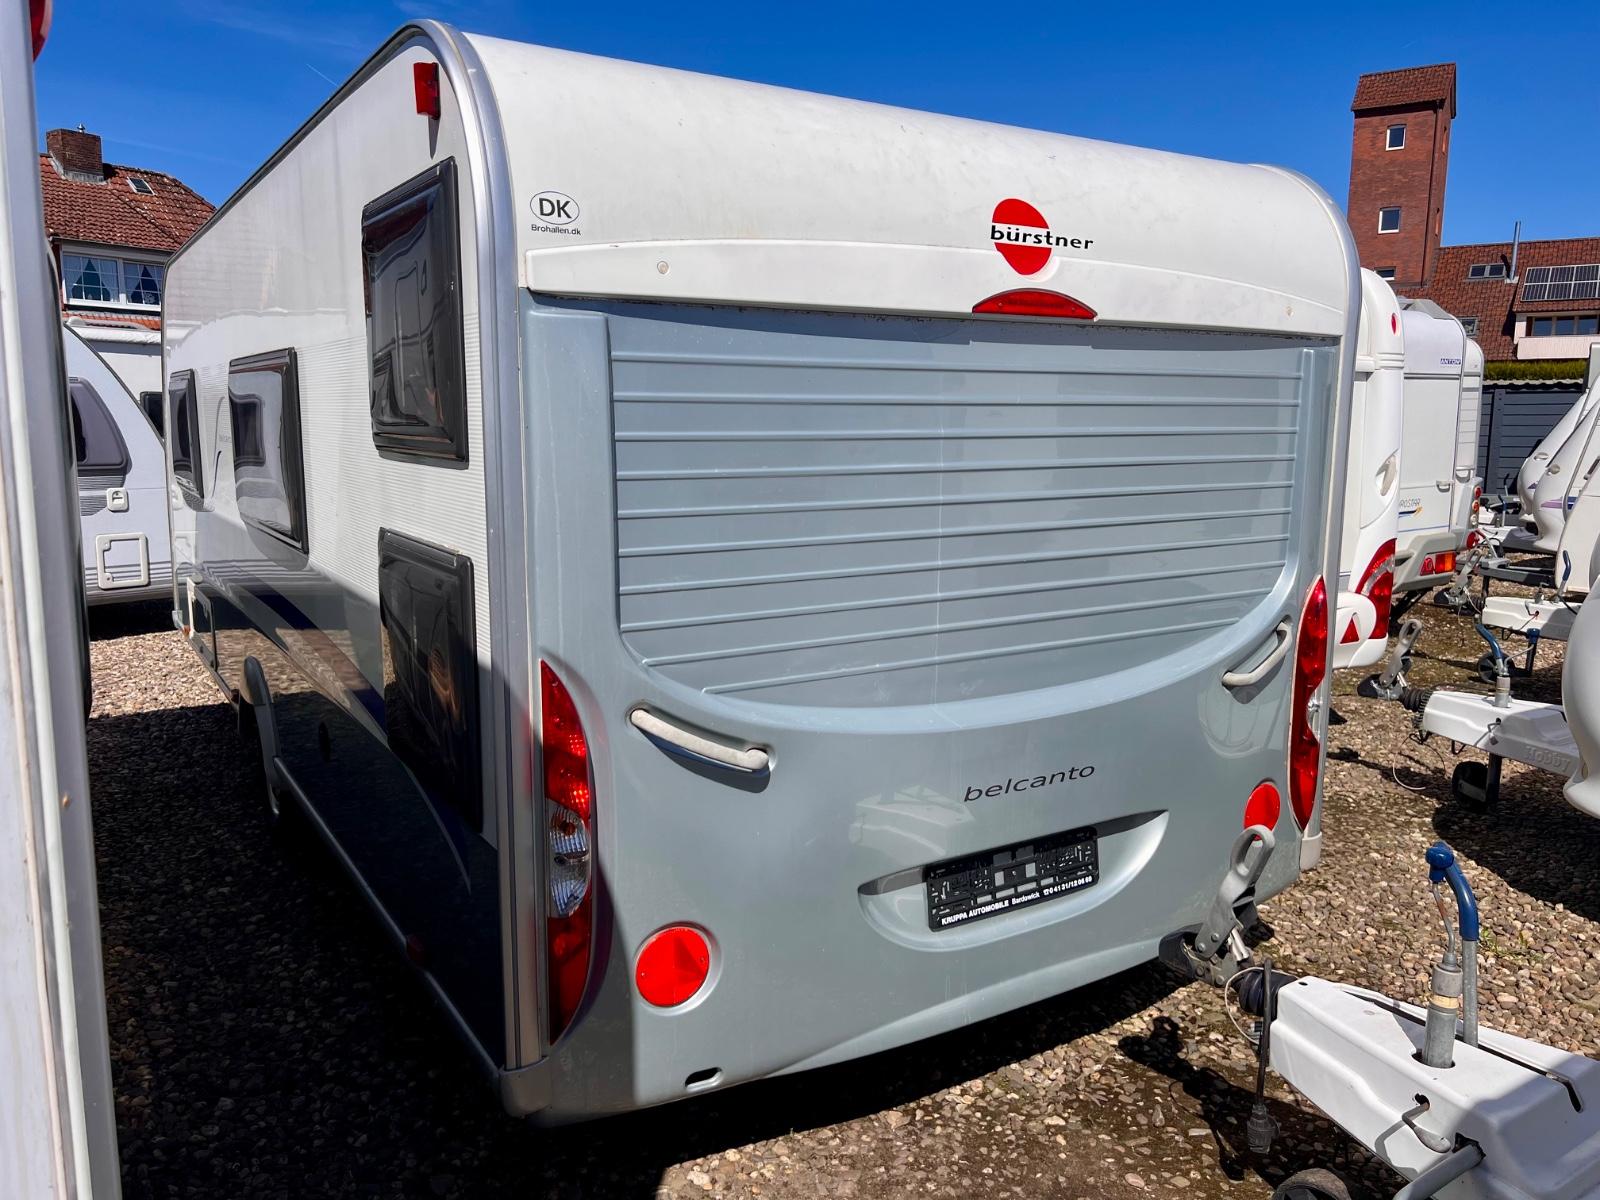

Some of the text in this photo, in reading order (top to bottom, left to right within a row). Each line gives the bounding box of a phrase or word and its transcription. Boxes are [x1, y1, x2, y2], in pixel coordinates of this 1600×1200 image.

[539, 197, 572, 219] DK
[531, 223, 581, 236] Brohallen.dk
[990, 225, 1094, 249] bürstner
[963, 765, 1095, 802] belcanto
[941, 911, 968, 926] KRUPPA
[968, 899, 1009, 918] AUTOMOBILE
